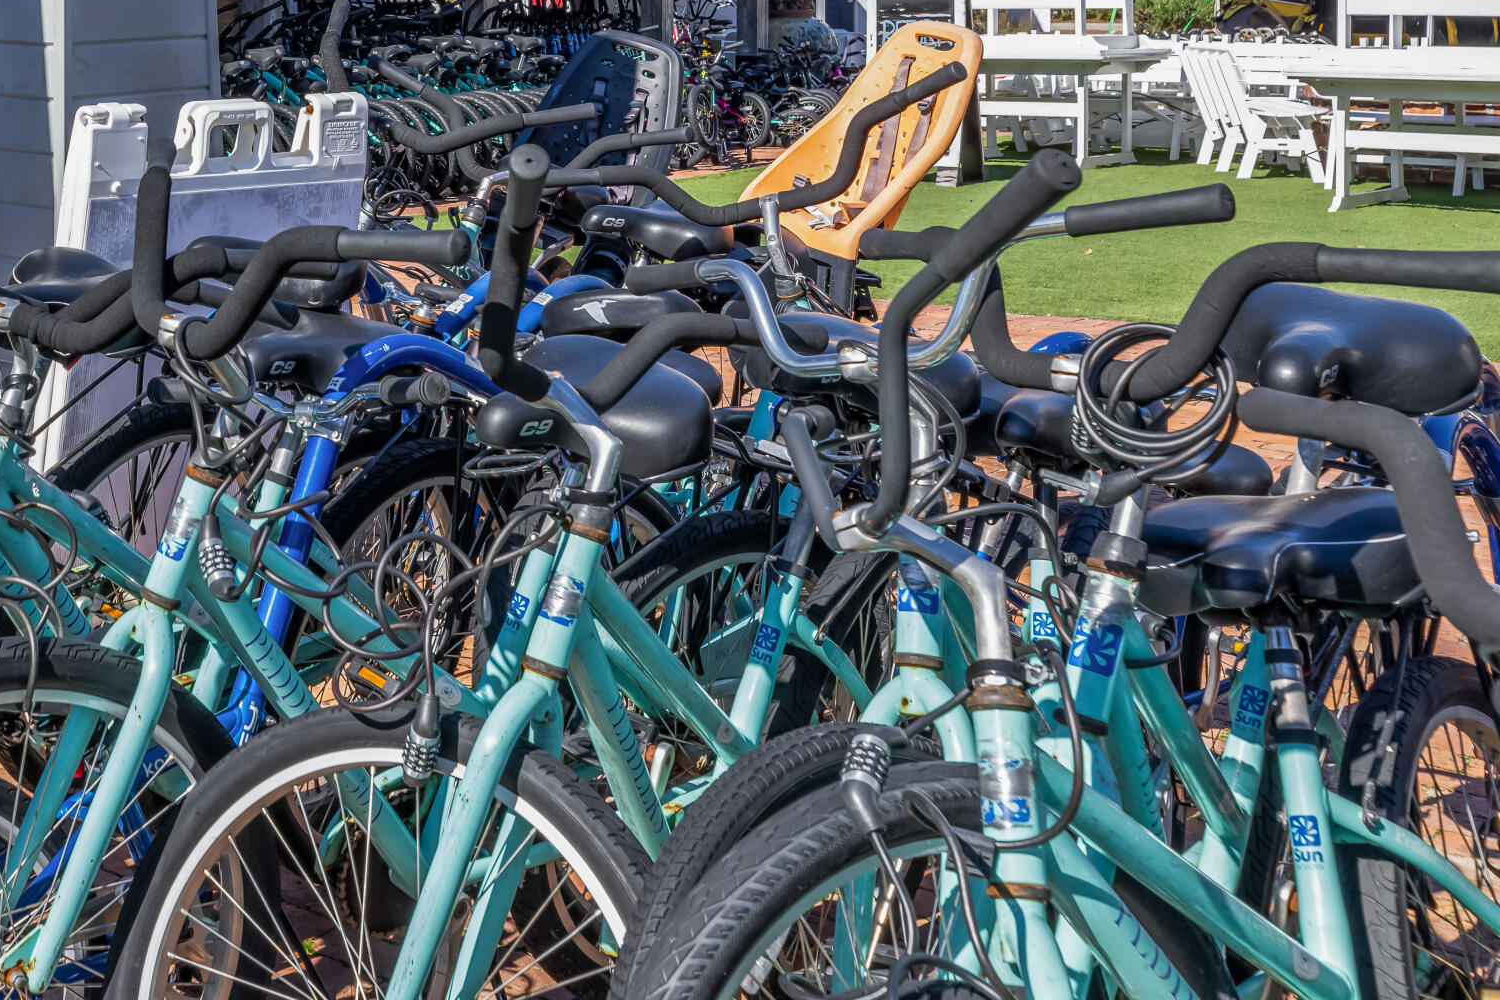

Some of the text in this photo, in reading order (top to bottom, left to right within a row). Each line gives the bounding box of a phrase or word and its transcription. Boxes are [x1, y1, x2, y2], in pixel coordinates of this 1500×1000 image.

[602, 217, 626, 228] C9
[269, 360, 297, 375] C9
[519, 419, 554, 437] C9
